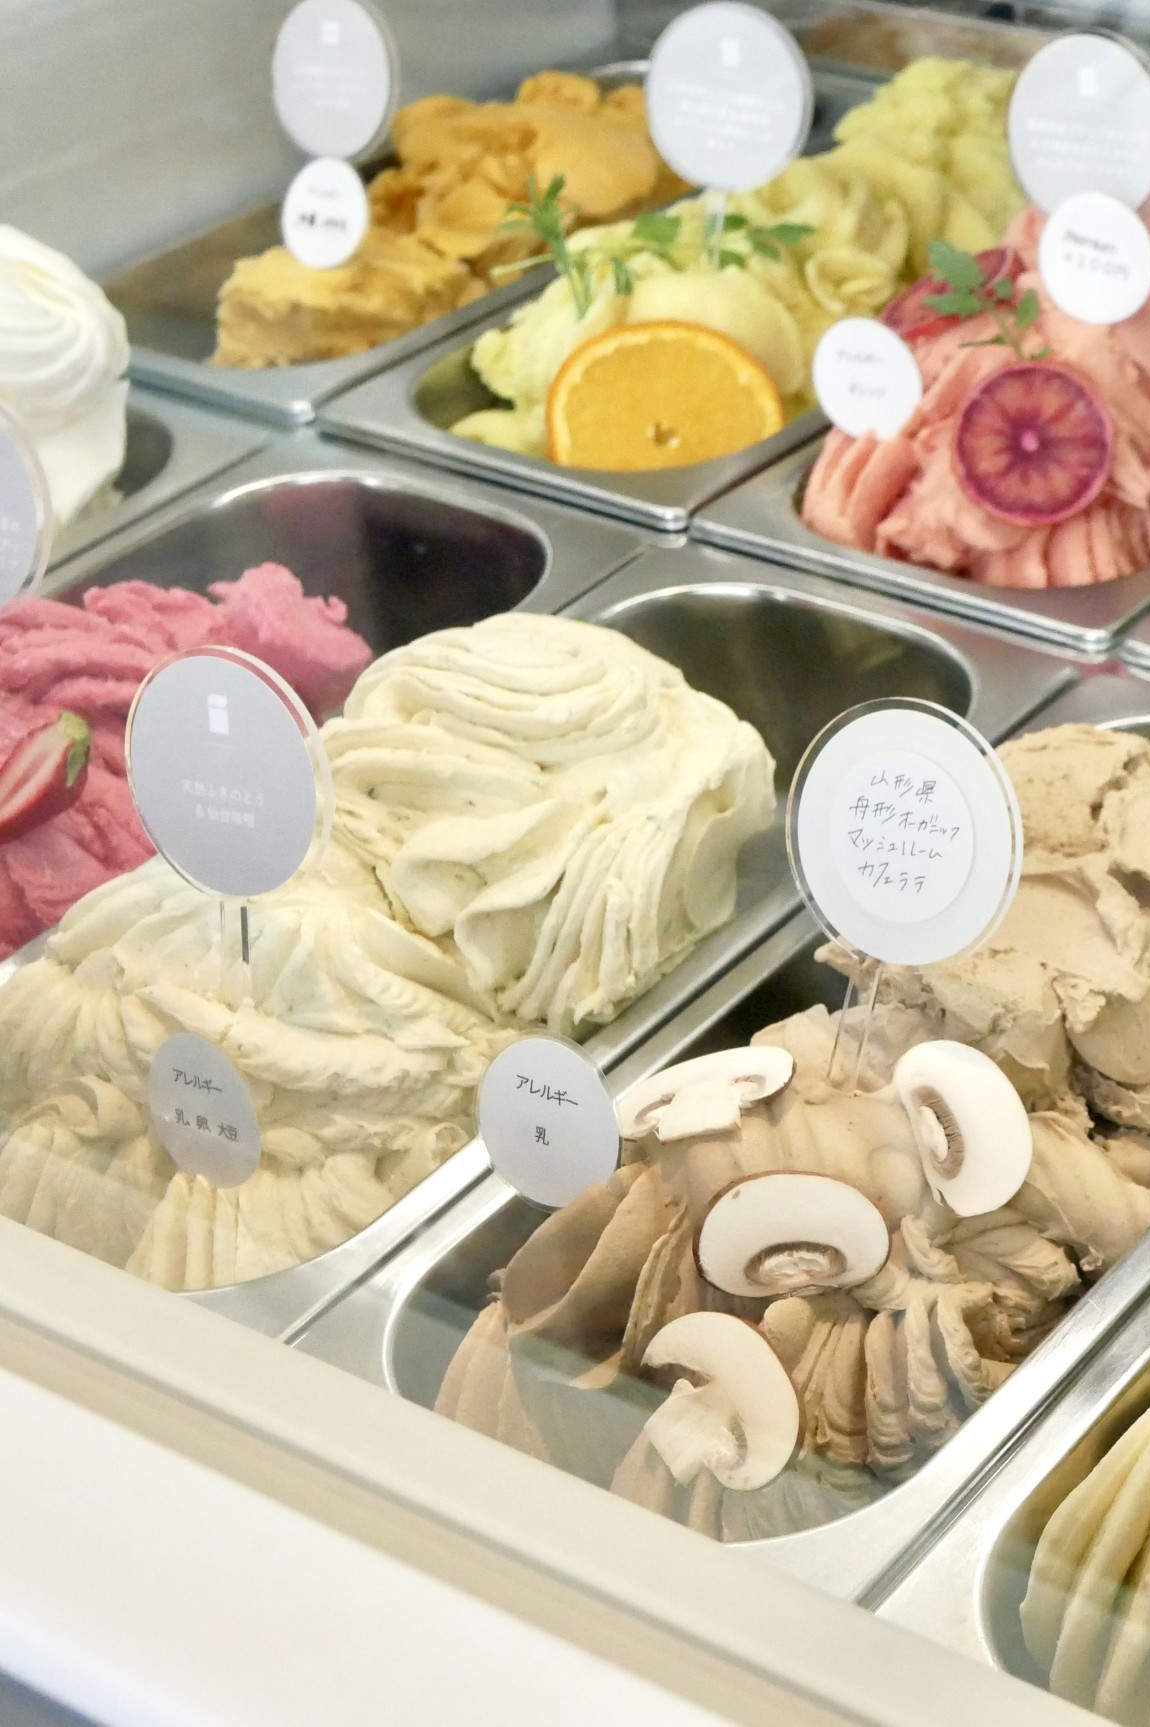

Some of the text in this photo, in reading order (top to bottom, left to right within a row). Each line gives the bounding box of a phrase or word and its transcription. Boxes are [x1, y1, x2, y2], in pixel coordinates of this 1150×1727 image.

[870, 770, 936, 804] 山形県
[847, 828, 943, 859] マッシュルーム
[858, 861, 926, 894] カフェラテ
[172, 1068, 222, 1092] アレルギー
[516, 1074, 579, 1106] アレルギー
[535, 1125, 549, 1146] 乳
